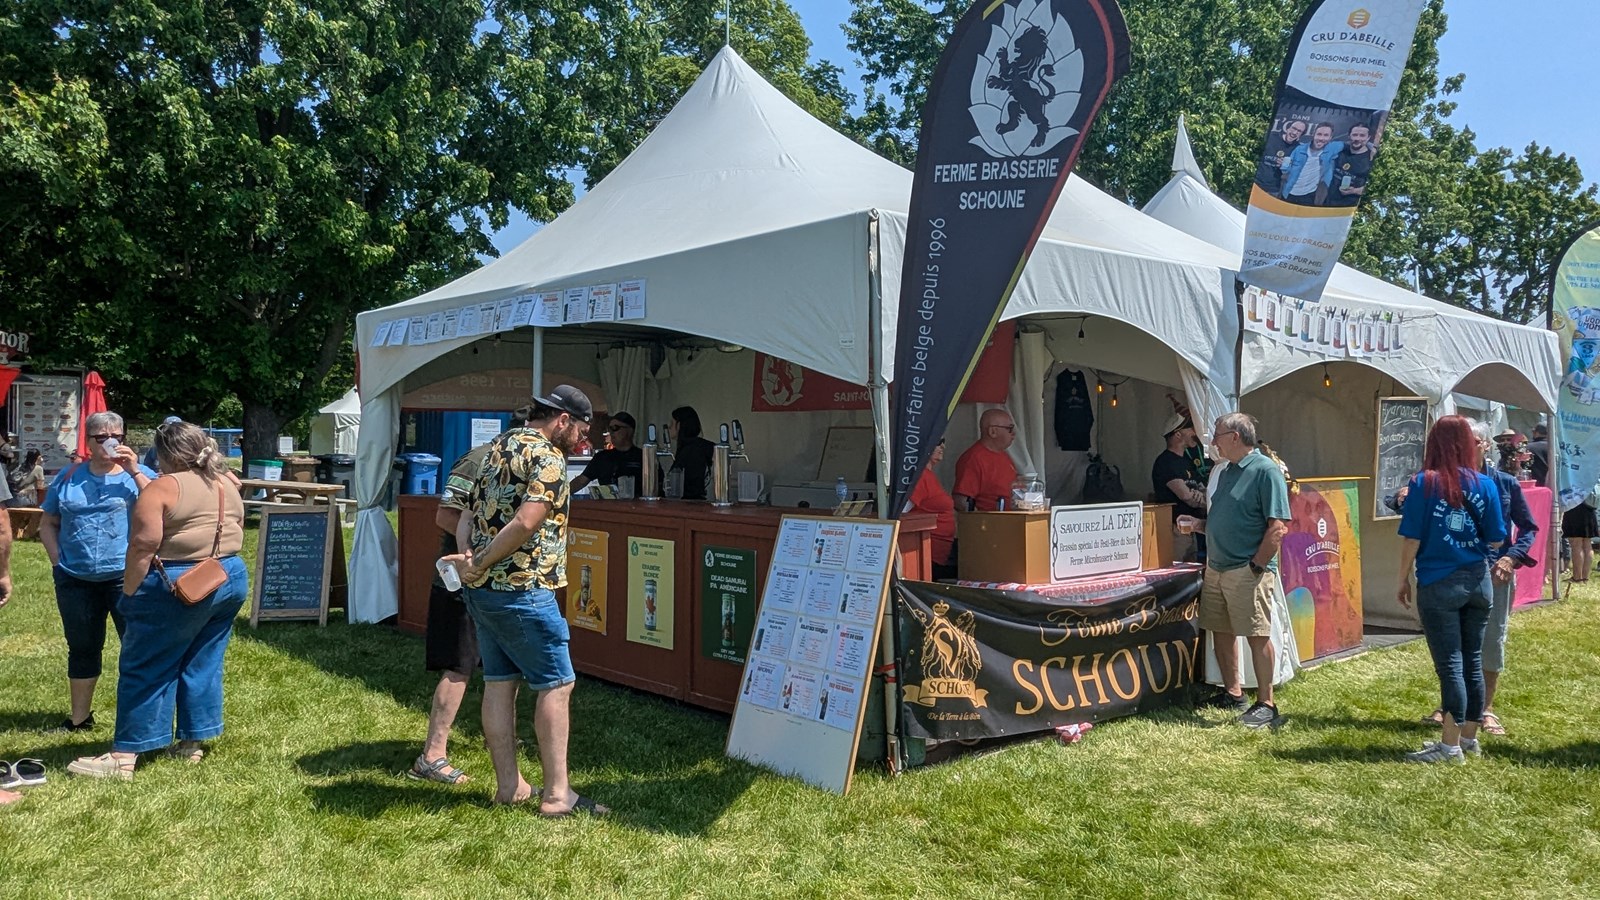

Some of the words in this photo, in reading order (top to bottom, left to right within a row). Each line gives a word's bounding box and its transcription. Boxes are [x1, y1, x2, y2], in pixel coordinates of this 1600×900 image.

[1311, 33, 1335, 42] CRU
[1340, 32, 1395, 51] D'ABEILLE
[1310, 53, 1350, 63] BOISSONS
[1350, 54, 1366, 64] PUR
[1367, 58, 1387, 67] MIEL
[934, 163, 978, 183] FERME
[981, 158, 1059, 180] BRASSERIE
[959, 189, 1026, 210] SCHOUNE
[929, 217, 947, 259] 1996
[1293, 255, 1308, 263] PUR
[918, 263, 940, 320] depuis
[0, 331, 30, 353] TOR
[911, 325, 934, 370] belge
[903, 375, 925, 472] savoir-faire
[1060, 521, 1100, 534] SAVOUREZ
[1102, 514, 1114, 531] LA
[1117, 509, 1137, 530] DÉFI
[1305, 543, 1316, 556] CRU
[1012, 637, 1199, 715] SCHOUN
